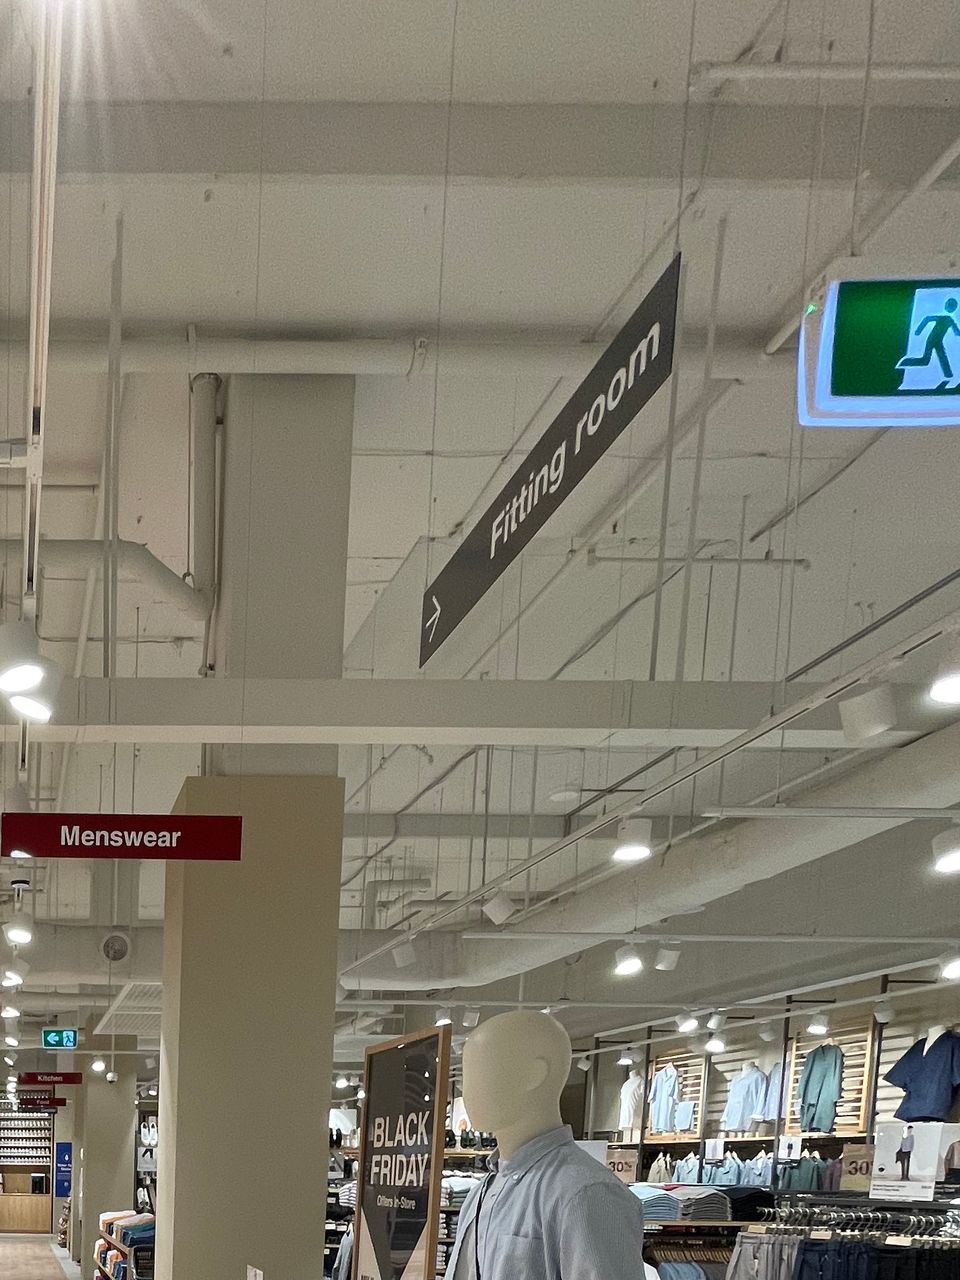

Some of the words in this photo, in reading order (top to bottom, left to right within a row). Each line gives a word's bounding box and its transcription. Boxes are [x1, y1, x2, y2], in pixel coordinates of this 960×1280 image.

[488, 440, 567, 560] Fitting
[573, 319, 661, 454] room
[60, 825, 182, 848] Menswear
[373, 1110, 430, 1149] BLACK
[370, 1153, 429, 1187] FRIDAY
[377, 1194, 393, 1208] Offers
[393, 1195, 416, 1210] In-Store
